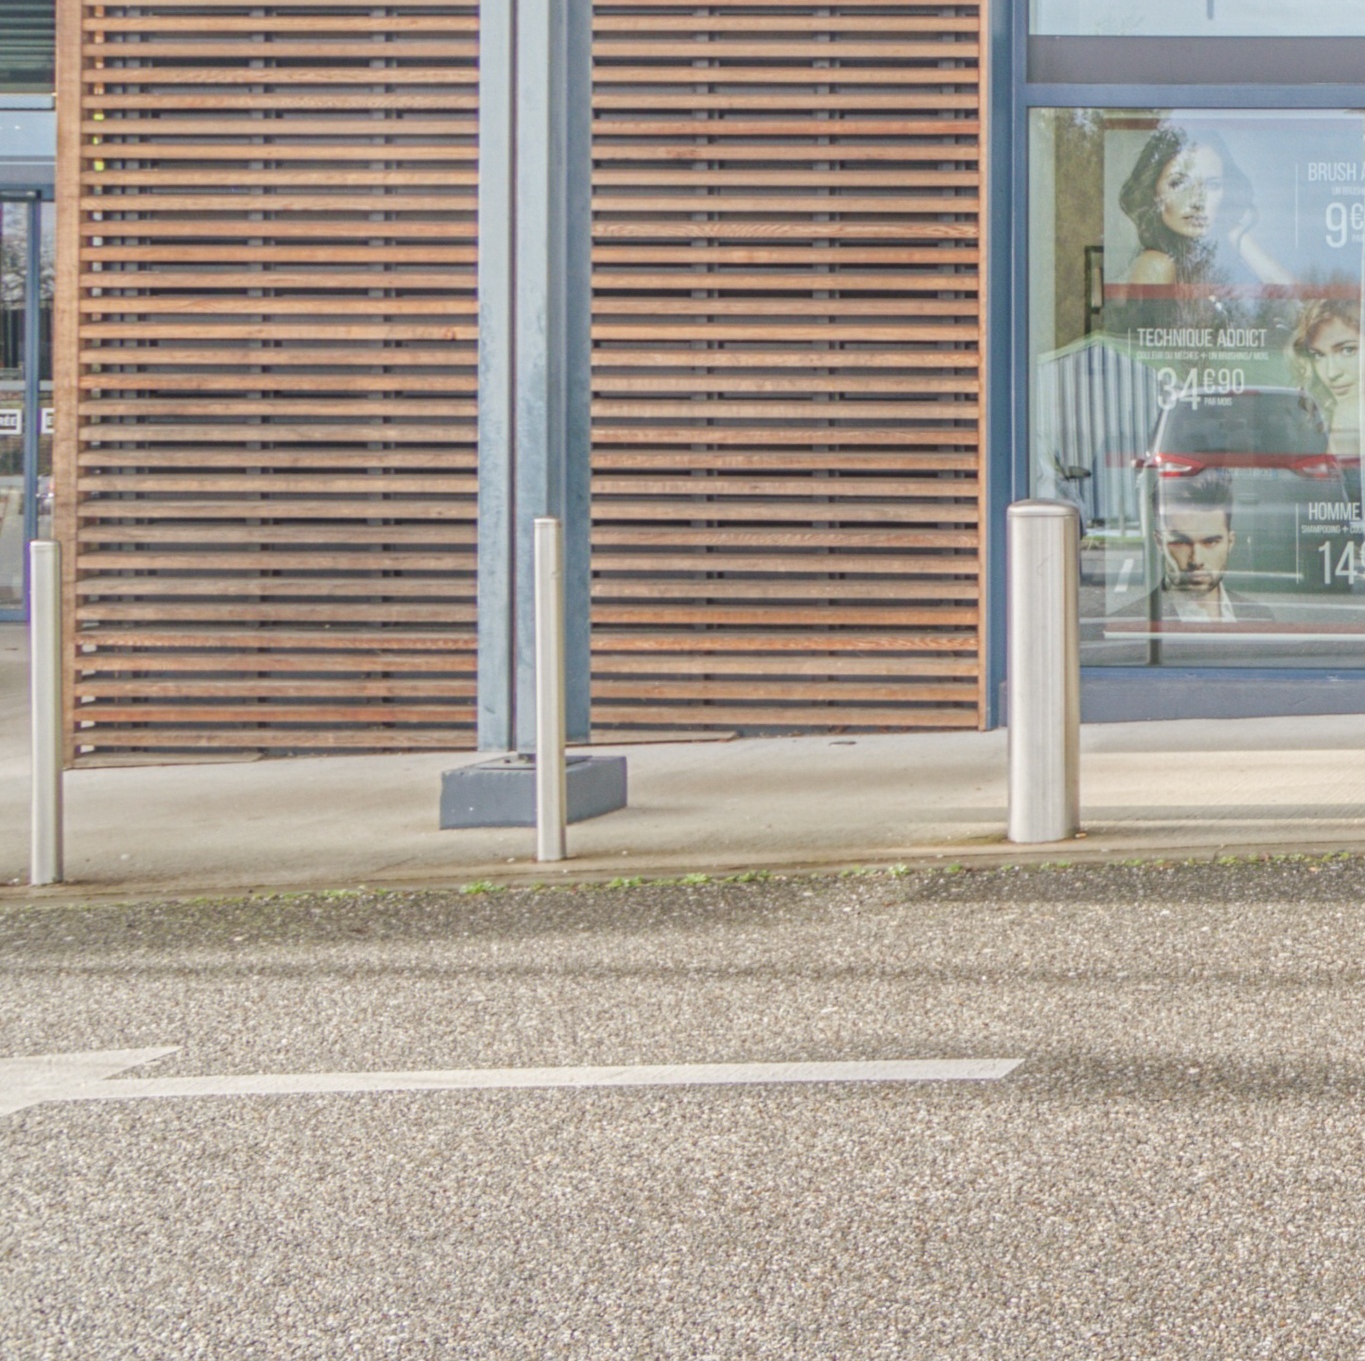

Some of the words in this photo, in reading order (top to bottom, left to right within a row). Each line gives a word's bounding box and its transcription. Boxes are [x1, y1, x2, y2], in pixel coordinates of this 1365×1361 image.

[1308, 162, 1357, 181] BRUSH
[1137, 328, 1214, 347] TECHNIQUE
[1217, 328, 1267, 347] ADDICT
[1308, 502, 1360, 521] HOMME
